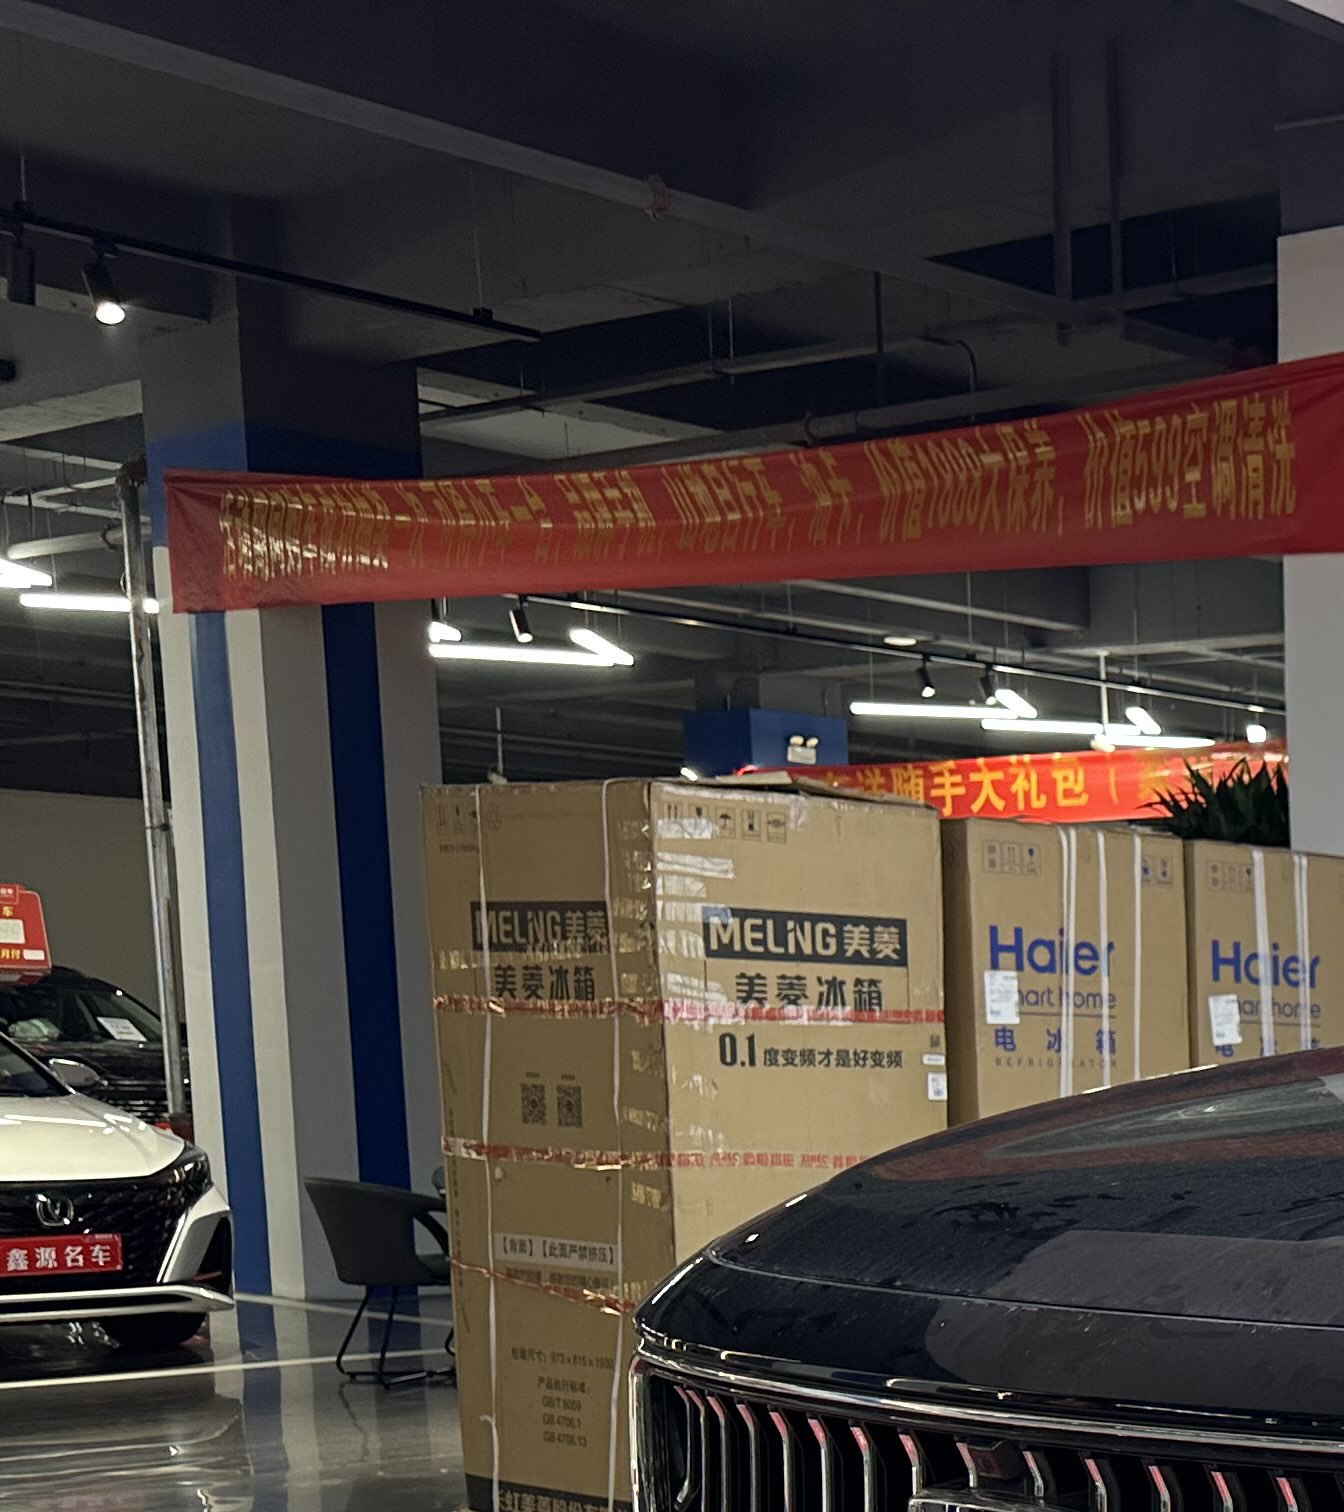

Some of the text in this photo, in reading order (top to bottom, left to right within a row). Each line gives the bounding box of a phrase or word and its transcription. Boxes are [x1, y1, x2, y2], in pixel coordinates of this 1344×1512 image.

[989, 925, 1115, 977] Haier
[494, 964, 596, 1001] 美菱冰箱
[736, 973, 883, 1013] 美菱冰箱
[719, 1032, 903, 1069] 0.1 度变频才是好变频
[7, 1244, 111, 1272] 鑫源名车
